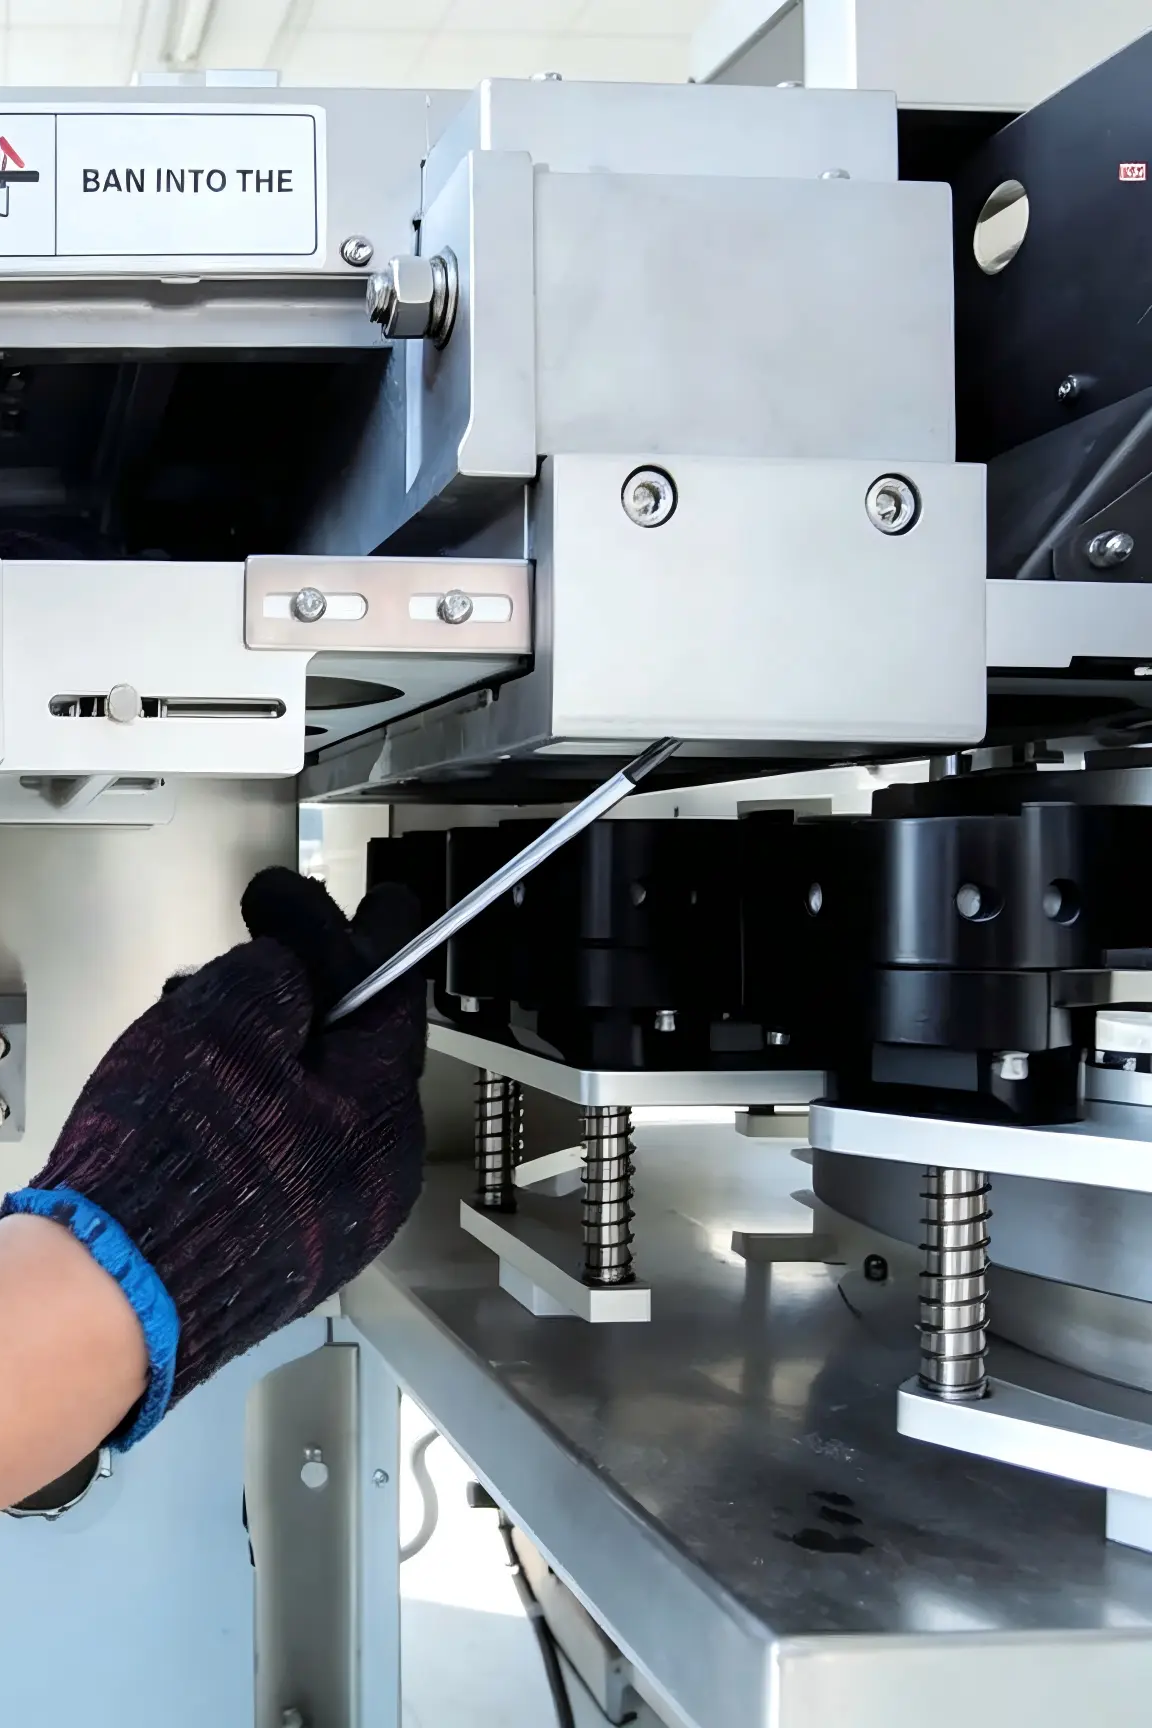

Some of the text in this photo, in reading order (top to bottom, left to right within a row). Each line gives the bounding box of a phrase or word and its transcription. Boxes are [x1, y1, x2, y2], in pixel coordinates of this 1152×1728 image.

[82, 168, 293, 193] BAN INTO THE
